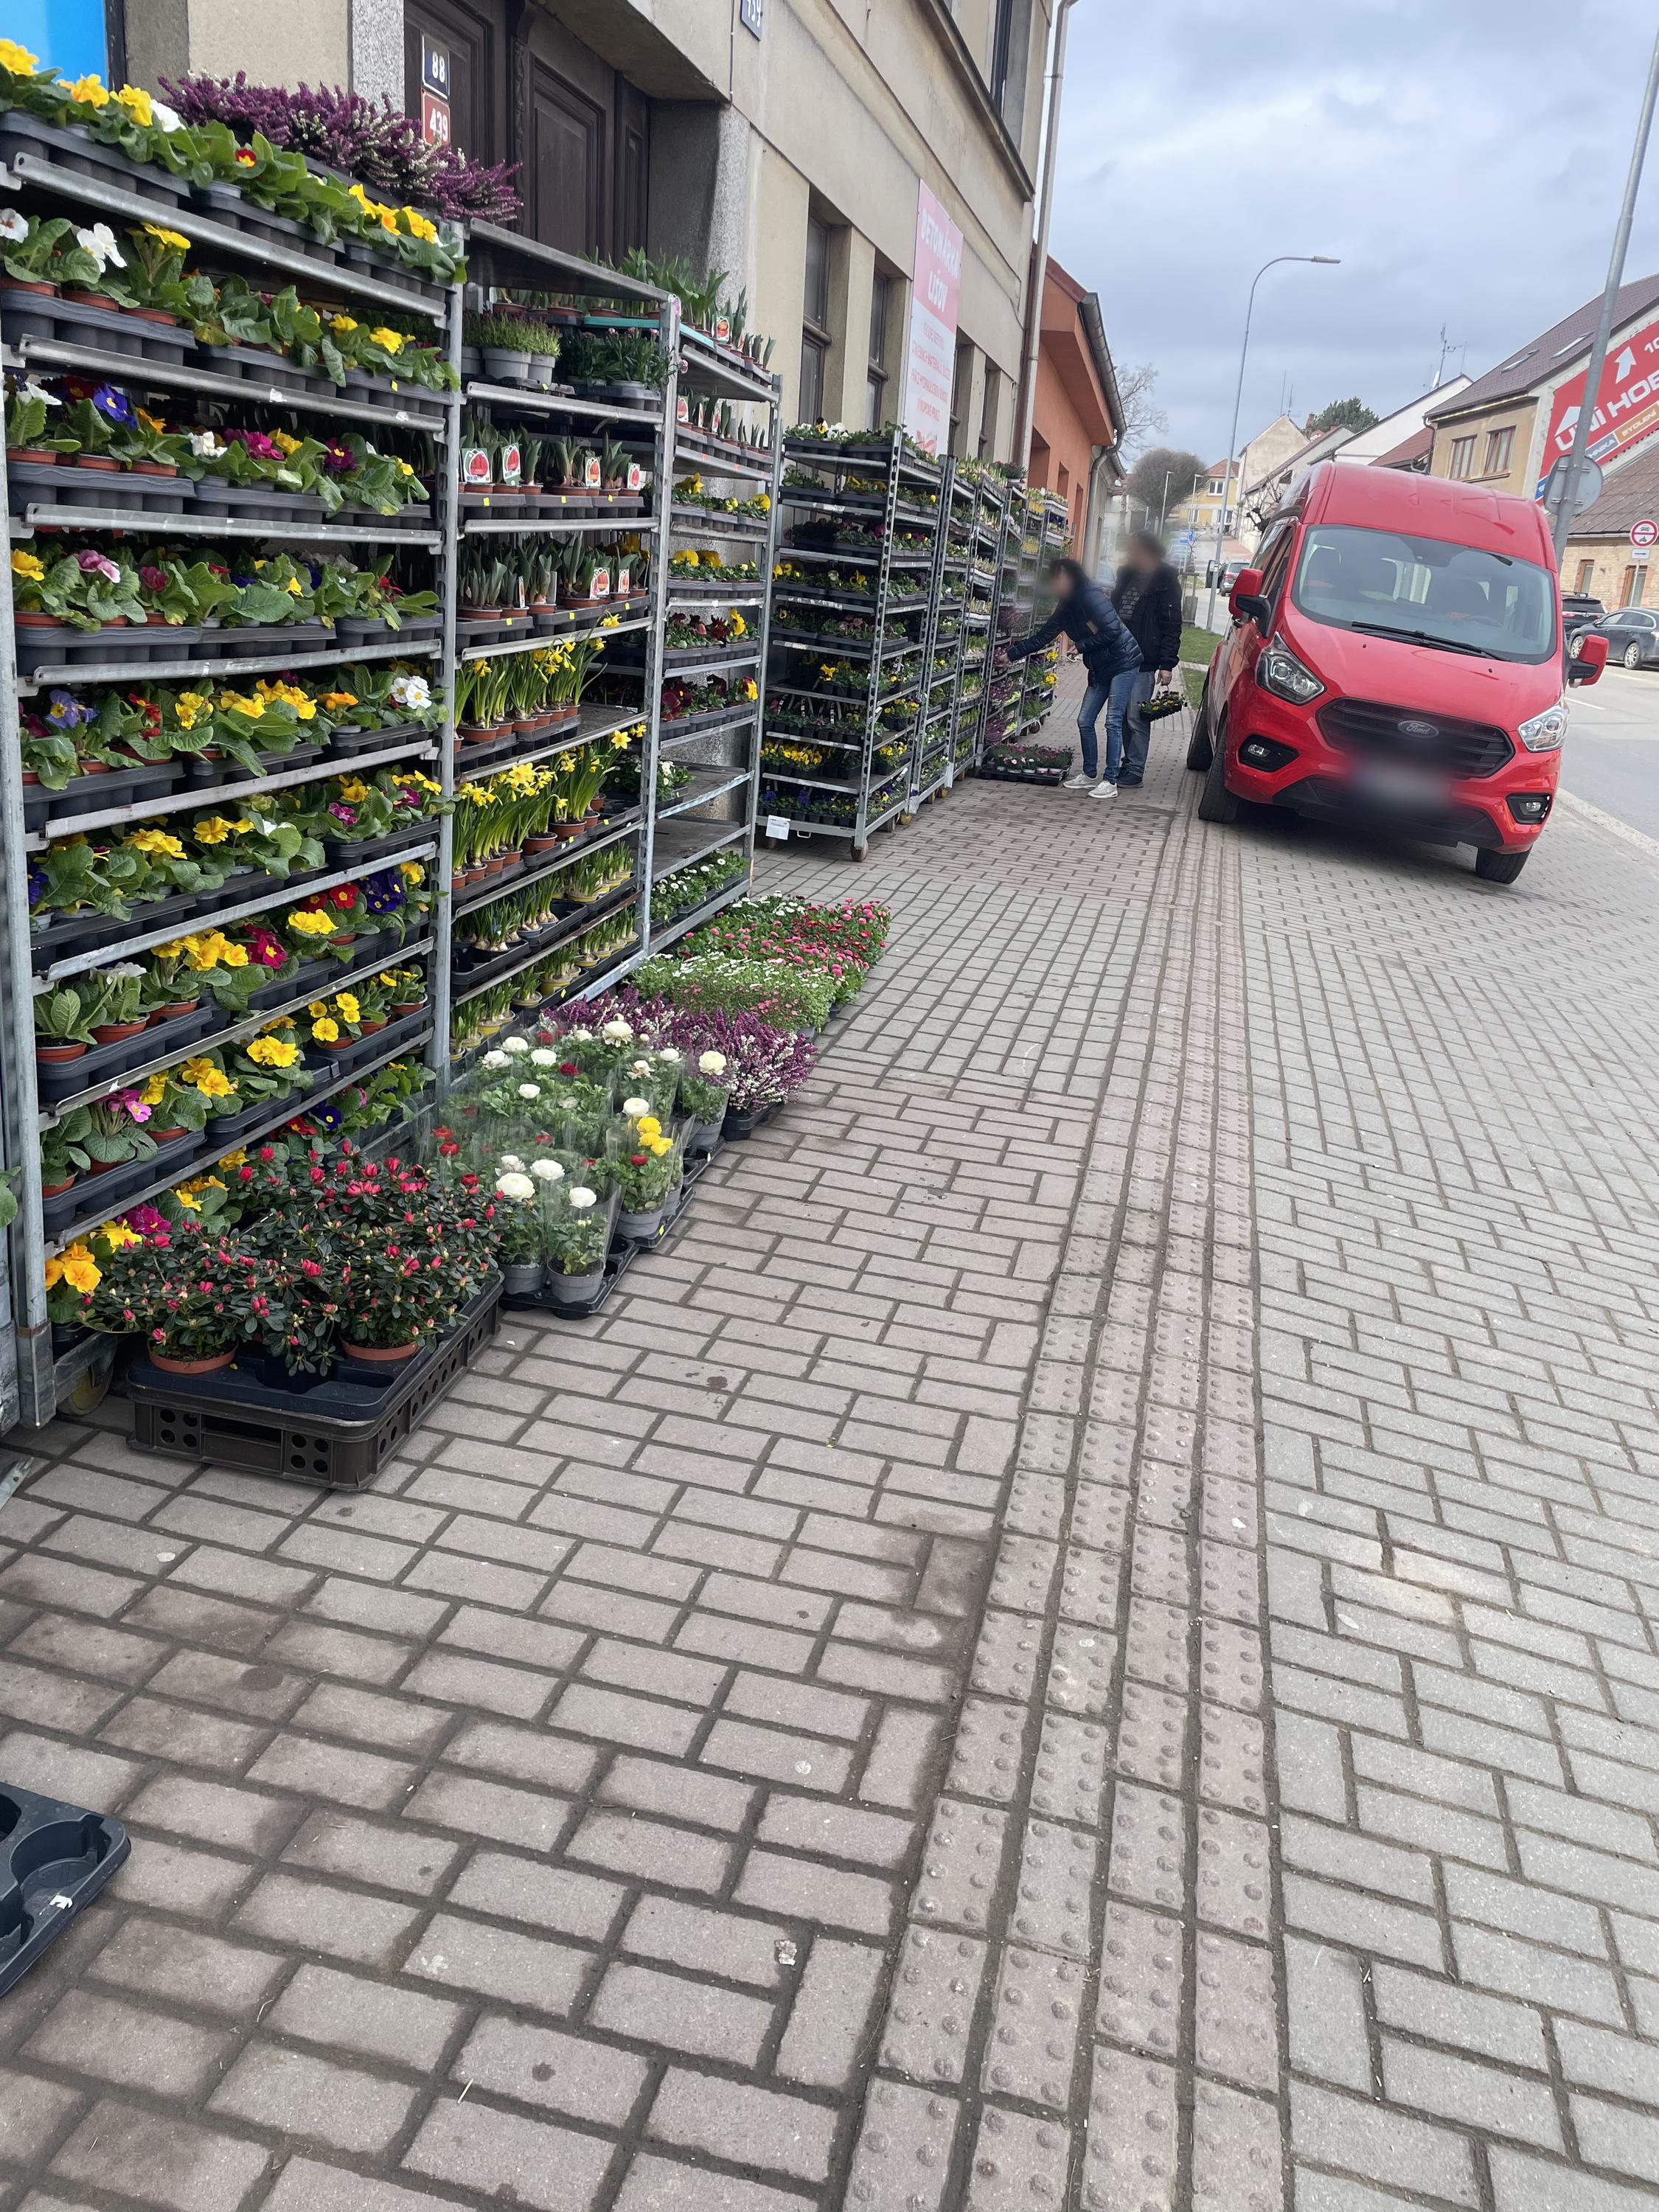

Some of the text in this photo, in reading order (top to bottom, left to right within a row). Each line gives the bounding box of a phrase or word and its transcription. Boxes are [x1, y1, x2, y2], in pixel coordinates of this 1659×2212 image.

[432, 51, 445, 83] 88
[429, 107, 448, 142] 439
[928, 269, 948, 313] LIŠOV
[1406, 722, 1431, 735] Ford
